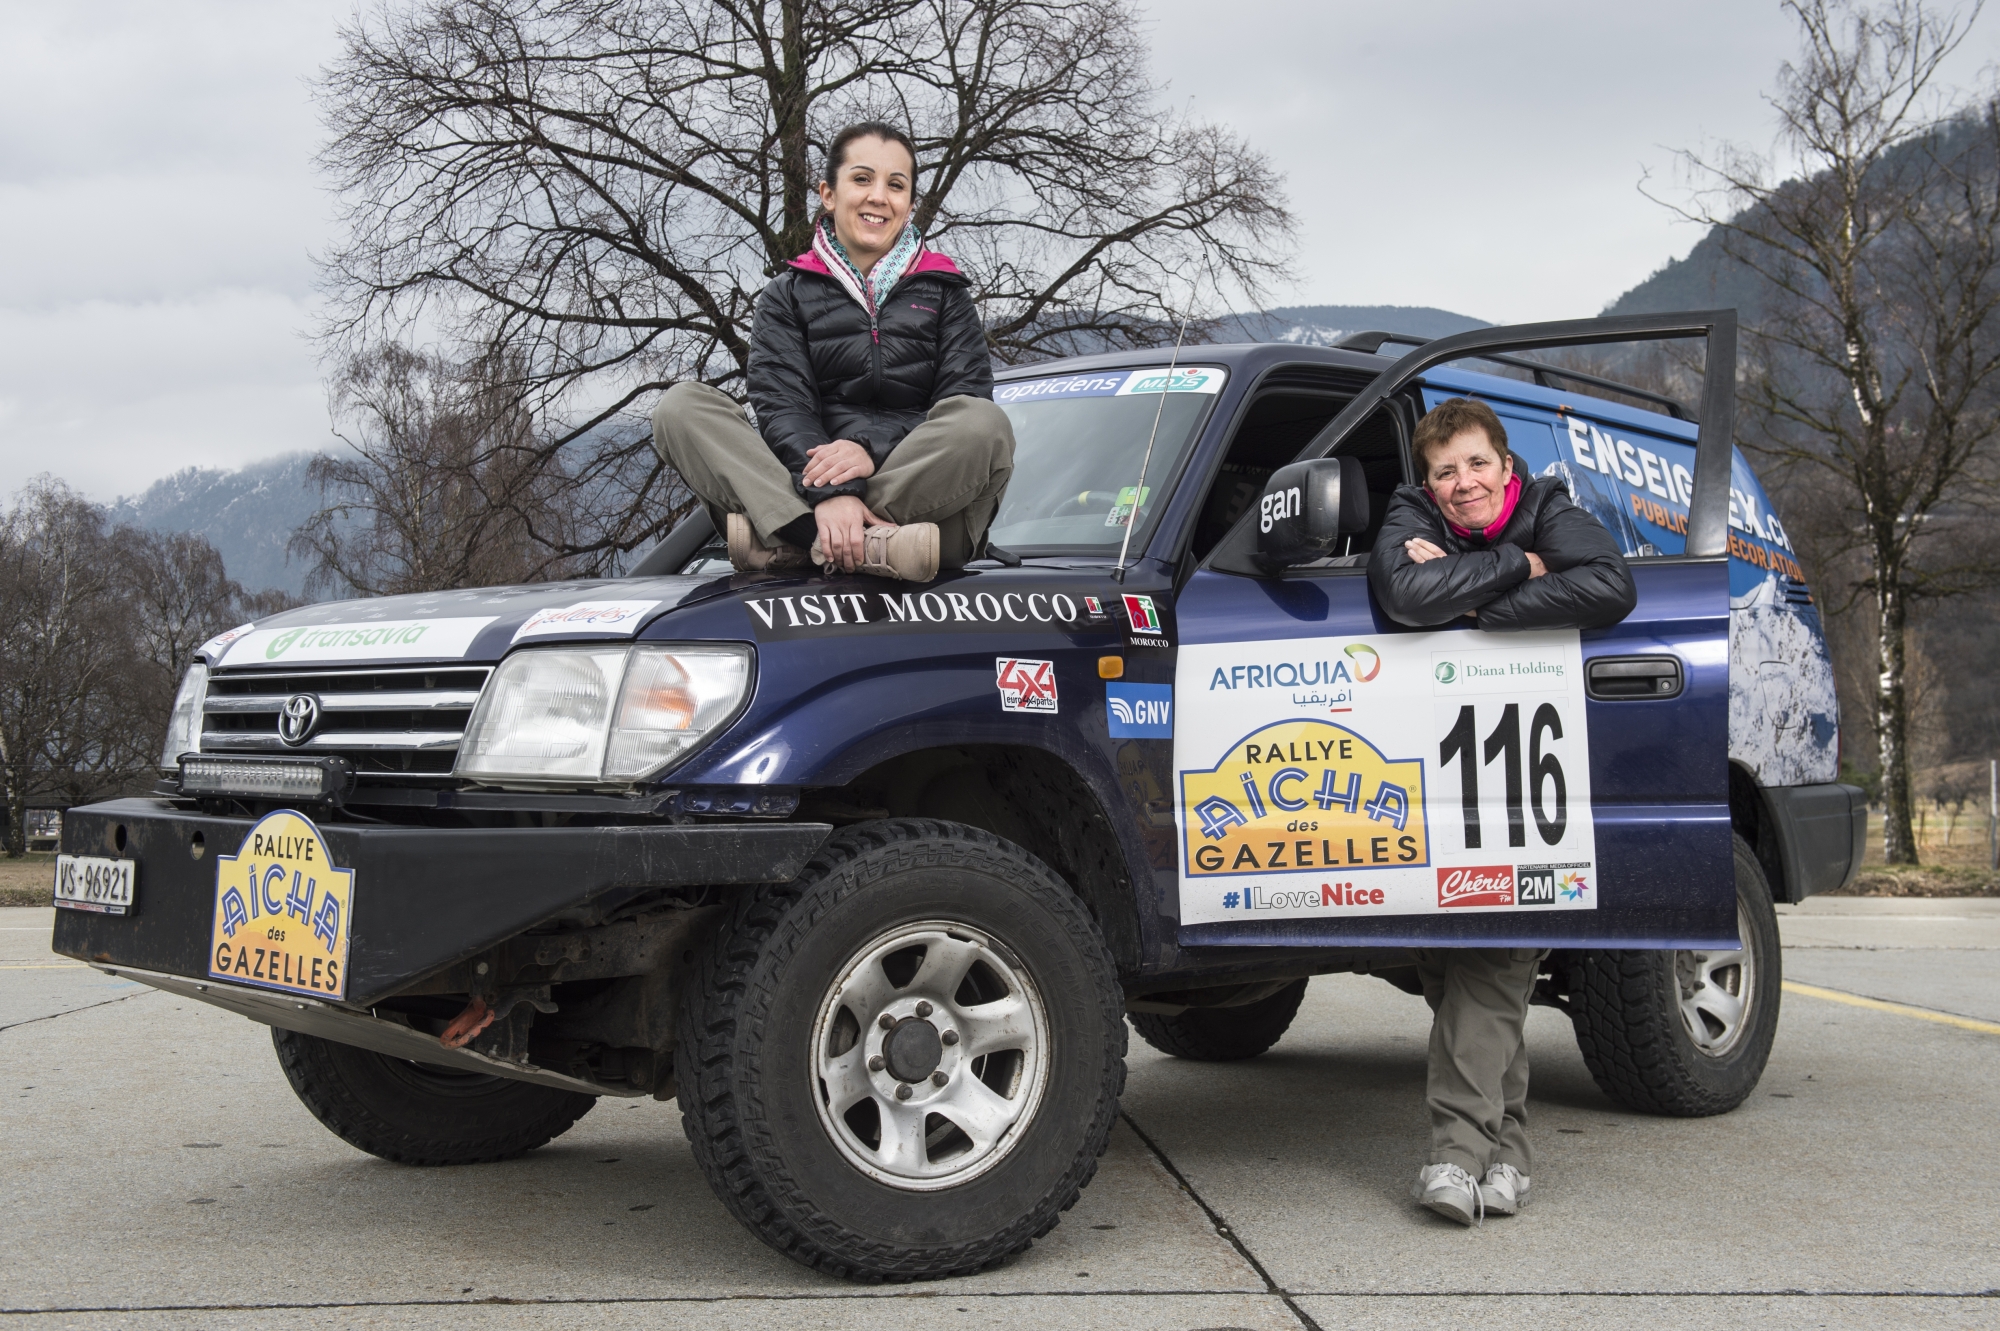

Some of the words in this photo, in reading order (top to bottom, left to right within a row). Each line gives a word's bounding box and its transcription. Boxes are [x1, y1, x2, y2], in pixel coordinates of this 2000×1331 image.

[1000, 377, 1121, 401] opticiens
[1261, 487, 1300, 533] gan
[746, 594, 870, 629] VISIT
[879, 592, 1077, 622] MOROCCO
[299, 623, 430, 648] transavia
[1130, 637, 1169, 648] MOROCCO
[1209, 660, 1352, 690] AFRIQUIA
[1466, 664, 1505, 677] Diana
[1509, 661, 1564, 677] Holding
[1135, 700, 1170, 724] GNV
[1246, 739, 1353, 764] RALLYE
[1439, 702, 1567, 849] 116
[1286, 820, 1319, 832] des
[254, 833, 314, 861] RALLYE
[1195, 835, 1418, 871] GAZELLES
[1441, 870, 1512, 897] Chérie
[1521, 876, 1553, 900] 2M
[267, 926, 286, 941] des
[216, 942, 338, 991] GAZELLES
